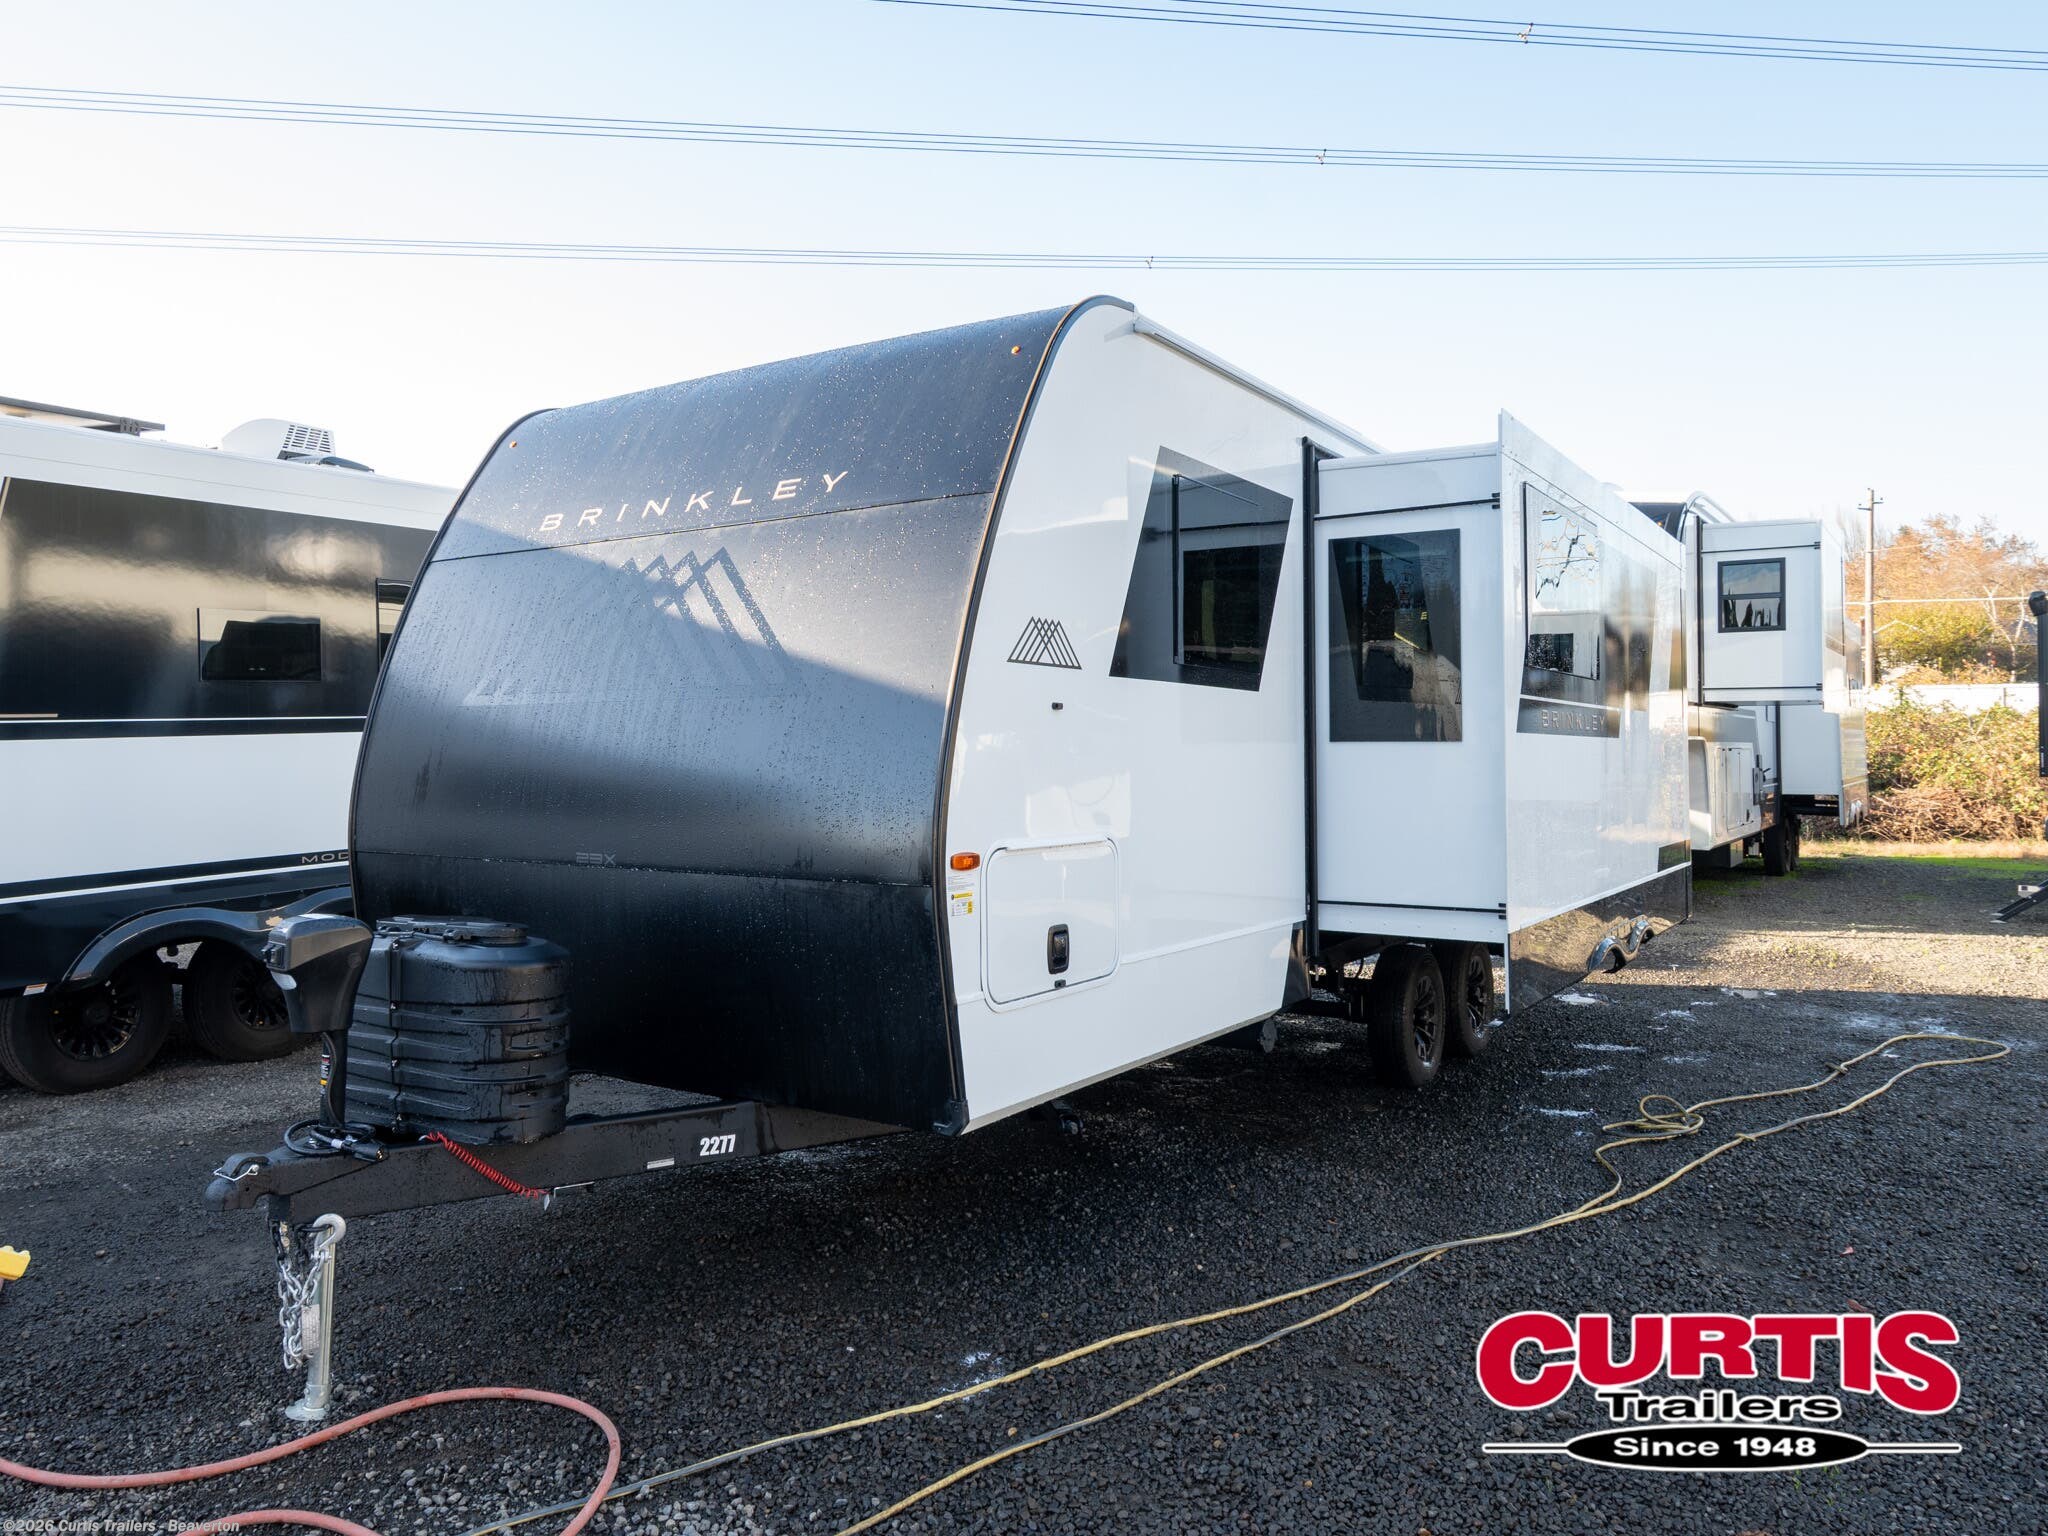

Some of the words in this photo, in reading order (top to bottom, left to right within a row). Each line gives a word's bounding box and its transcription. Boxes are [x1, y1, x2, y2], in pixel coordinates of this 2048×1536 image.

[538, 470, 849, 533] BRINKLEY
[1541, 709, 1605, 732] BRINKLEY
[700, 1134, 736, 1156] 2277
